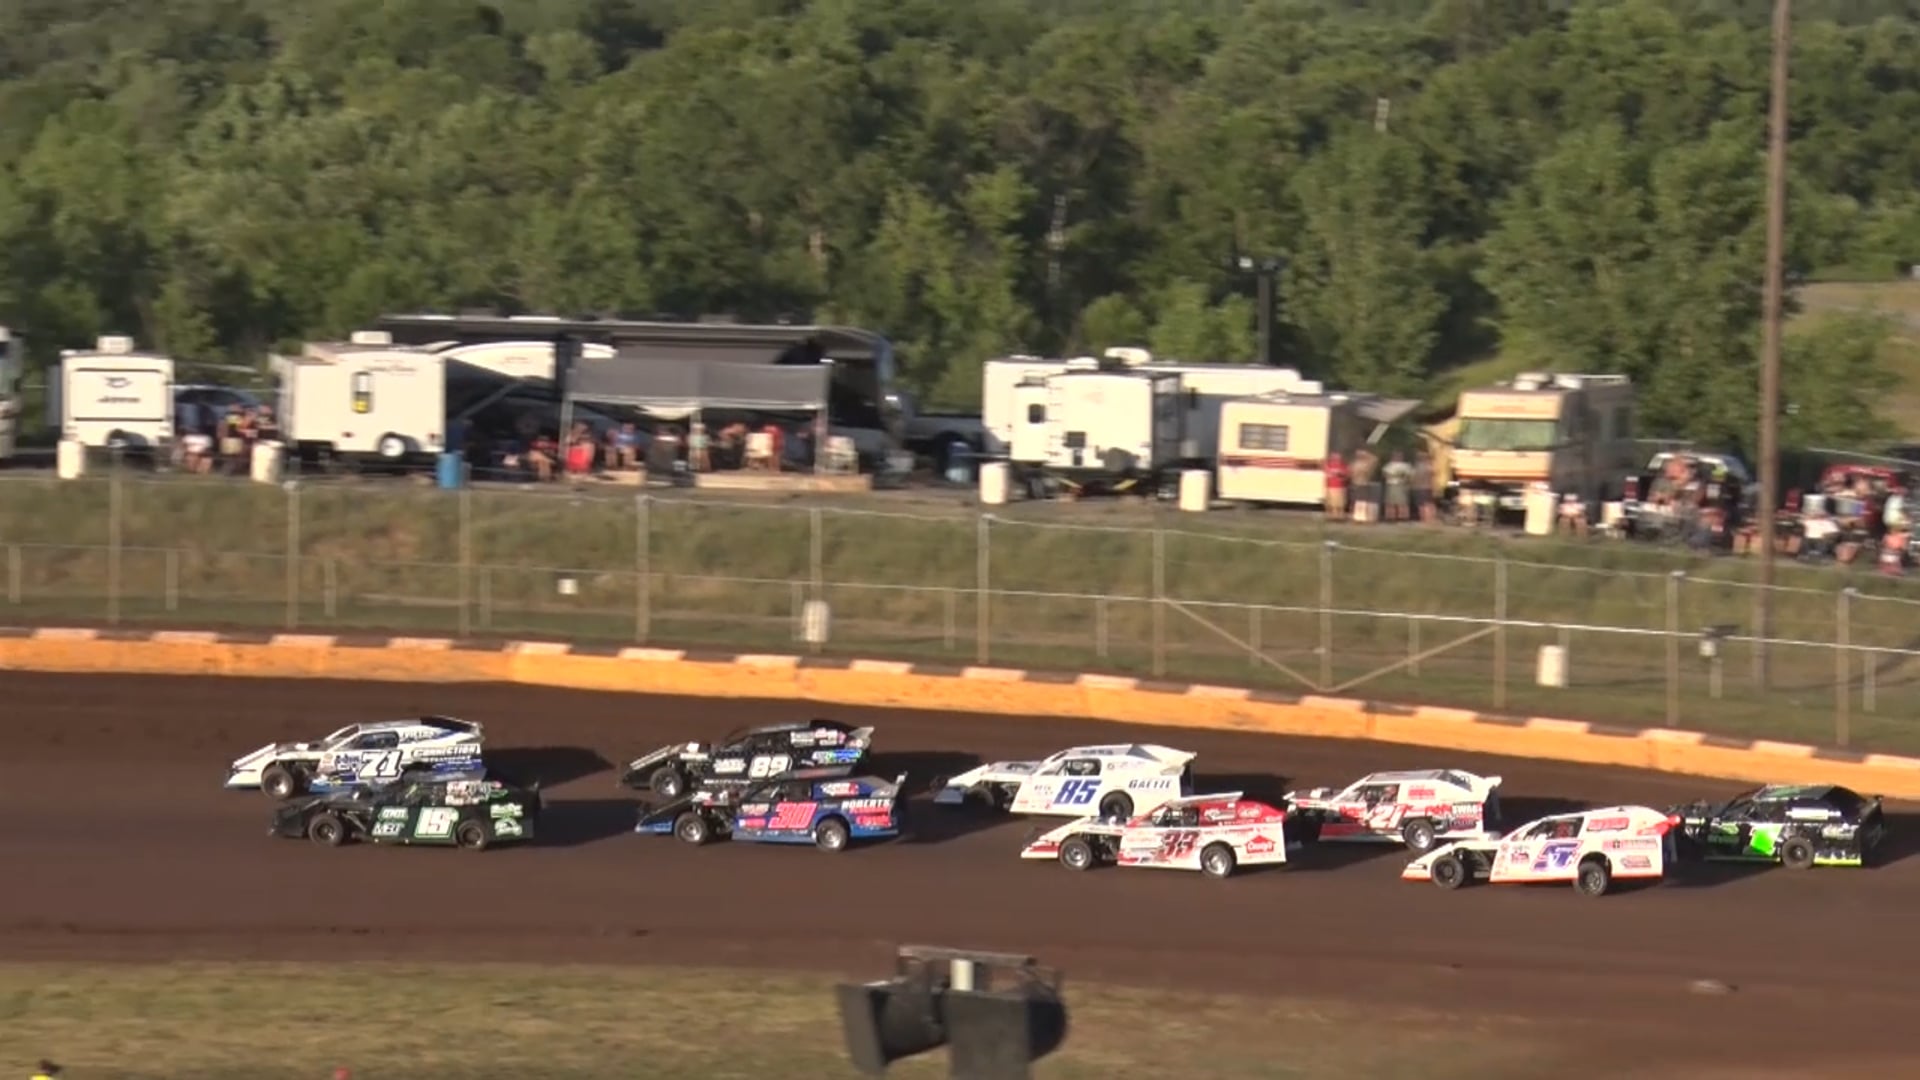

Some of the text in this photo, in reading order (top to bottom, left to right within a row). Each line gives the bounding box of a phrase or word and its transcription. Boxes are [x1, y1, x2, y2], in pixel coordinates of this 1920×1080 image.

[359, 750, 402, 778] 71
[749, 754, 789, 778] 89
[1053, 779, 1102, 805] 85
